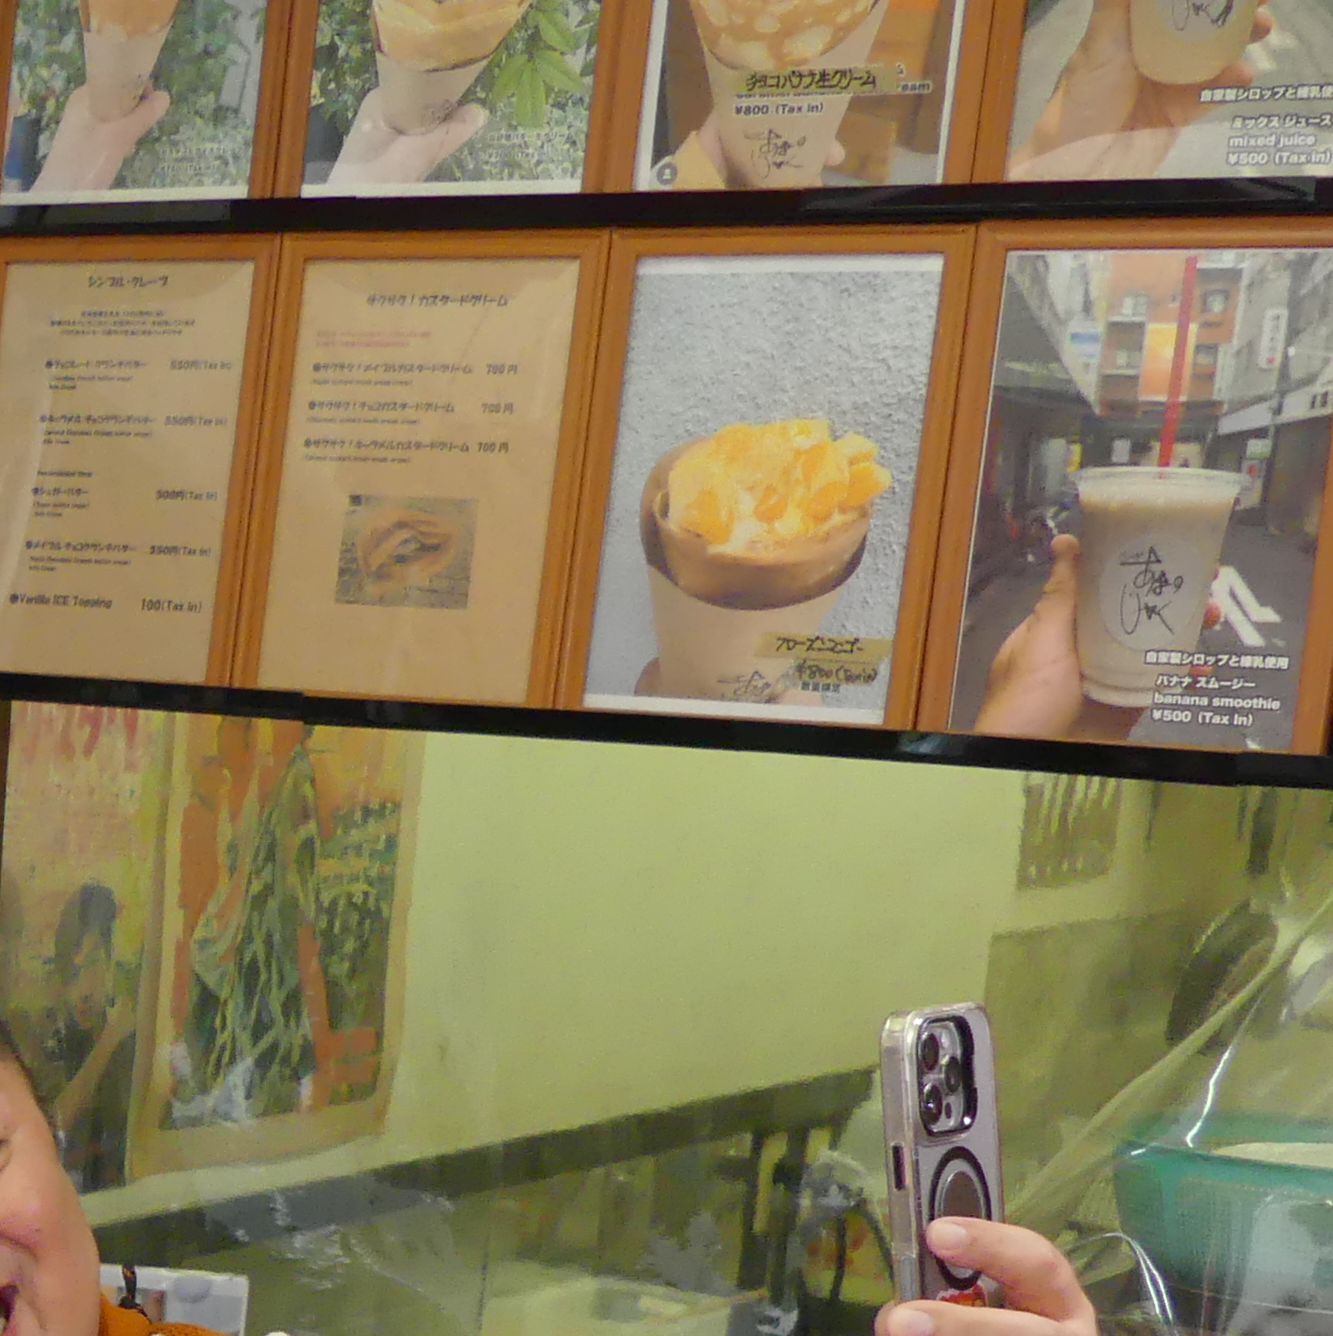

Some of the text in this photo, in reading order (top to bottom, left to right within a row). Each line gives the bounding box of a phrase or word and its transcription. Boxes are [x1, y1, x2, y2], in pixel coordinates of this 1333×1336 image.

[735, 105, 770, 116] ¥800
[1232, 114, 1332, 129] ミックス ジュース
[1229, 133, 1316, 149] mixed juice
[1227, 152, 1268, 165] ¥500
[1274, 151, 1307, 165] (Tax
[1156, 674, 1256, 690] バナナ スムージー
[1153, 692, 1281, 710] banana smoothie
[1151, 709, 1192, 723] ¥500
[1198, 711, 1230, 725] (Tax
